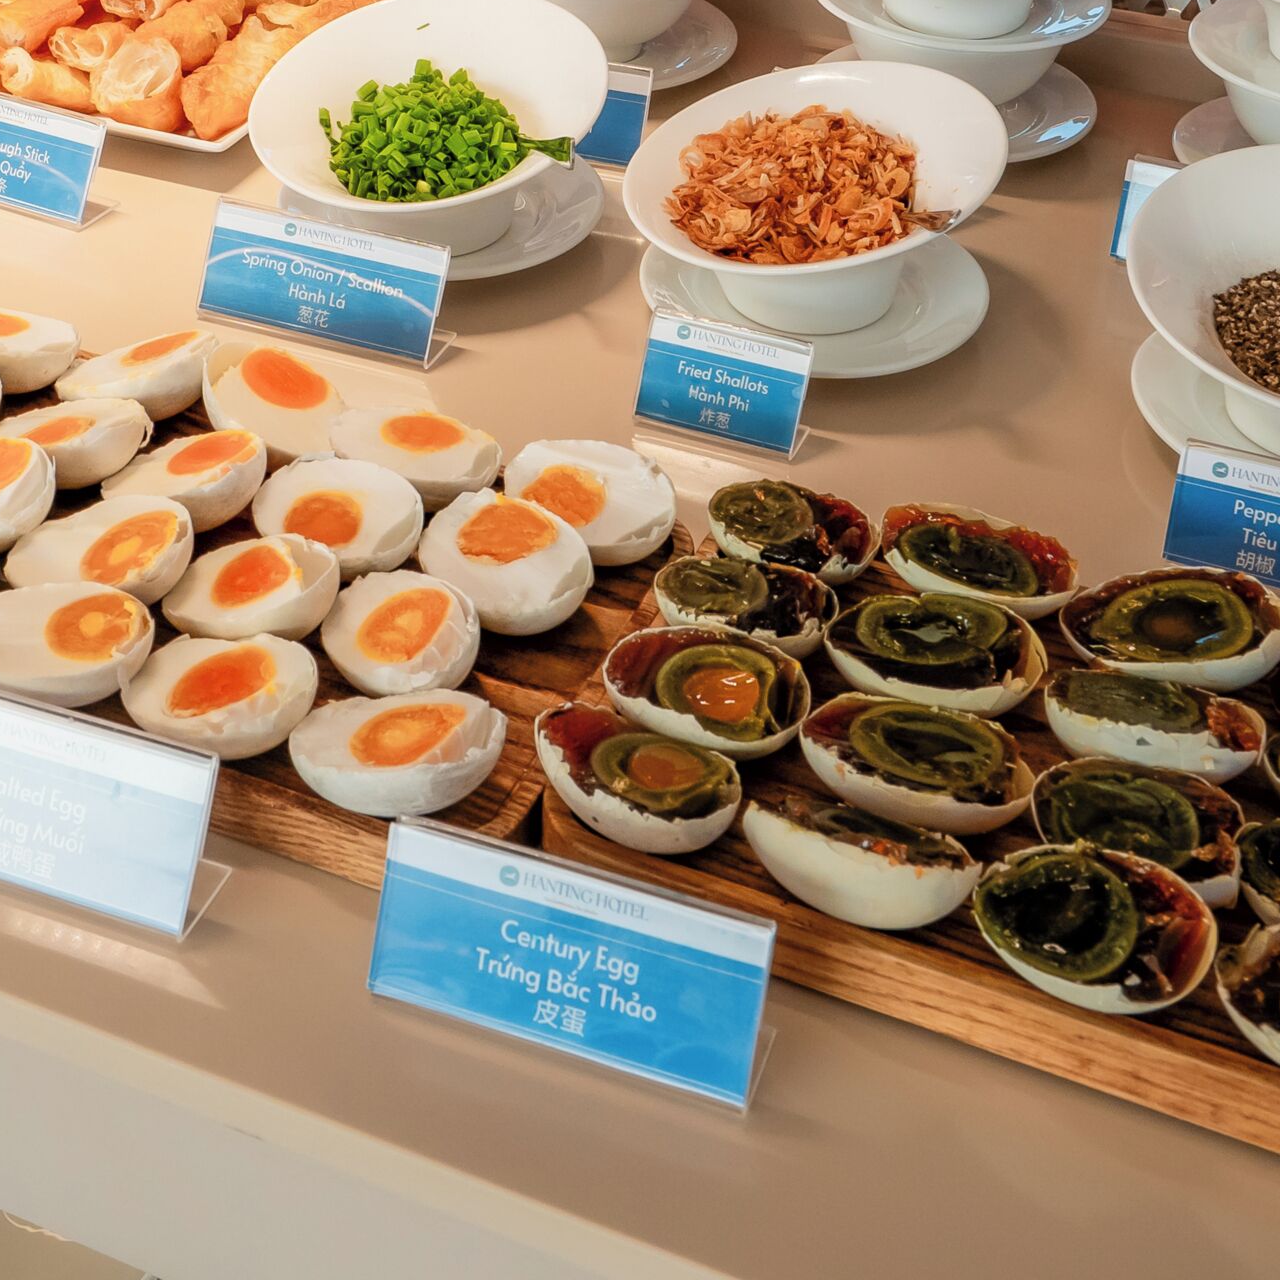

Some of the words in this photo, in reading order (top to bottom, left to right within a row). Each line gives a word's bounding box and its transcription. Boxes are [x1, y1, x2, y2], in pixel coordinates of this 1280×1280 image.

[24, 113, 48, 125] HOTEL
[24, 146, 50, 164] Stick
[299, 226, 341, 245] HANTING
[342, 235, 375, 252] HOTEL
[242, 249, 287, 276] Spring
[290, 259, 334, 283] Onion
[336, 269, 346, 287] /
[347, 272, 405, 299] Scallion
[289, 282, 326, 306] Hành
[330, 292, 347, 310] Lá
[297, 305, 331, 328] 葱花
[693, 329, 742, 349] HANTING
[743, 341, 779, 359] HOTEL
[678, 360, 713, 381] Fried
[714, 370, 769, 395] Shallots
[689, 385, 725, 406] Hành
[729, 395, 750, 413] Phi
[699, 407, 732, 429] 炸葱
[1242, 528, 1278, 551] Tiêu
[1236, 550, 1275, 576] 胡椒
[50, 790, 86, 824] Egg
[33, 822, 86, 856] Muối
[523, 872, 594, 904] HANTING
[596, 893, 647, 920] HOTEL
[501, 920, 591, 971] Century
[595, 946, 640, 986] Egg
[476, 947, 542, 994] Trứng
[546, 969, 592, 1003] Bắc
[598, 983, 657, 1023] Thảo
[533, 999, 587, 1038] 皮蛋
